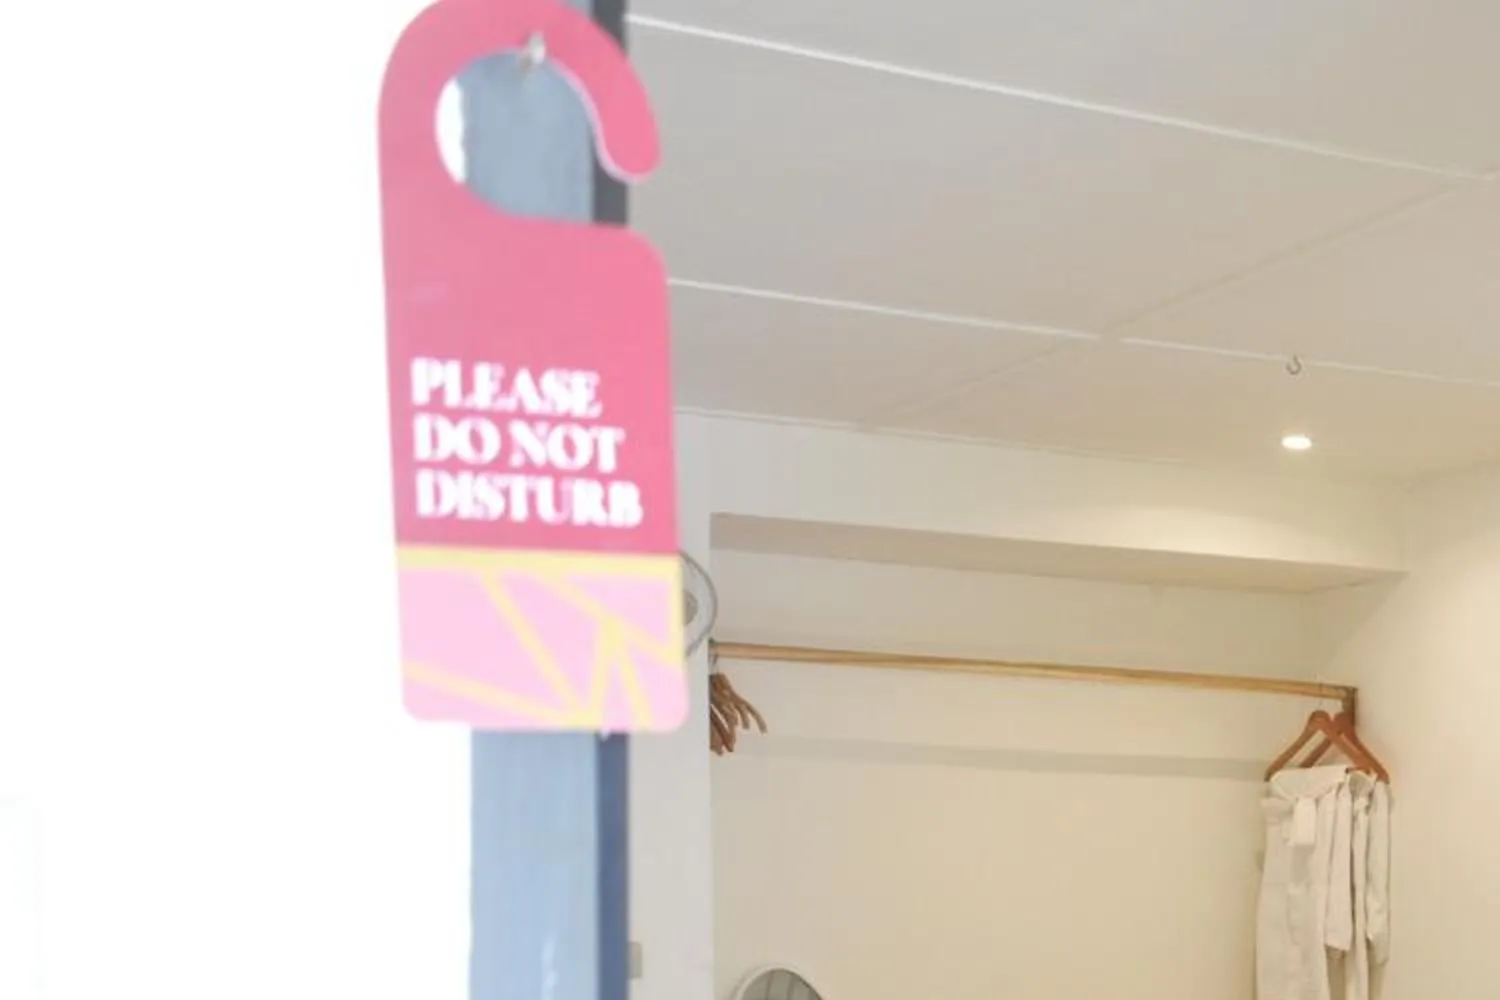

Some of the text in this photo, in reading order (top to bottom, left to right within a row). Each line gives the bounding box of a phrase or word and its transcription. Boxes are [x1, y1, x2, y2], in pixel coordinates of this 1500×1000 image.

[411, 357, 603, 419] PLEASE
[413, 412, 627, 474] DO NOT
[415, 467, 644, 529] DISTURB
